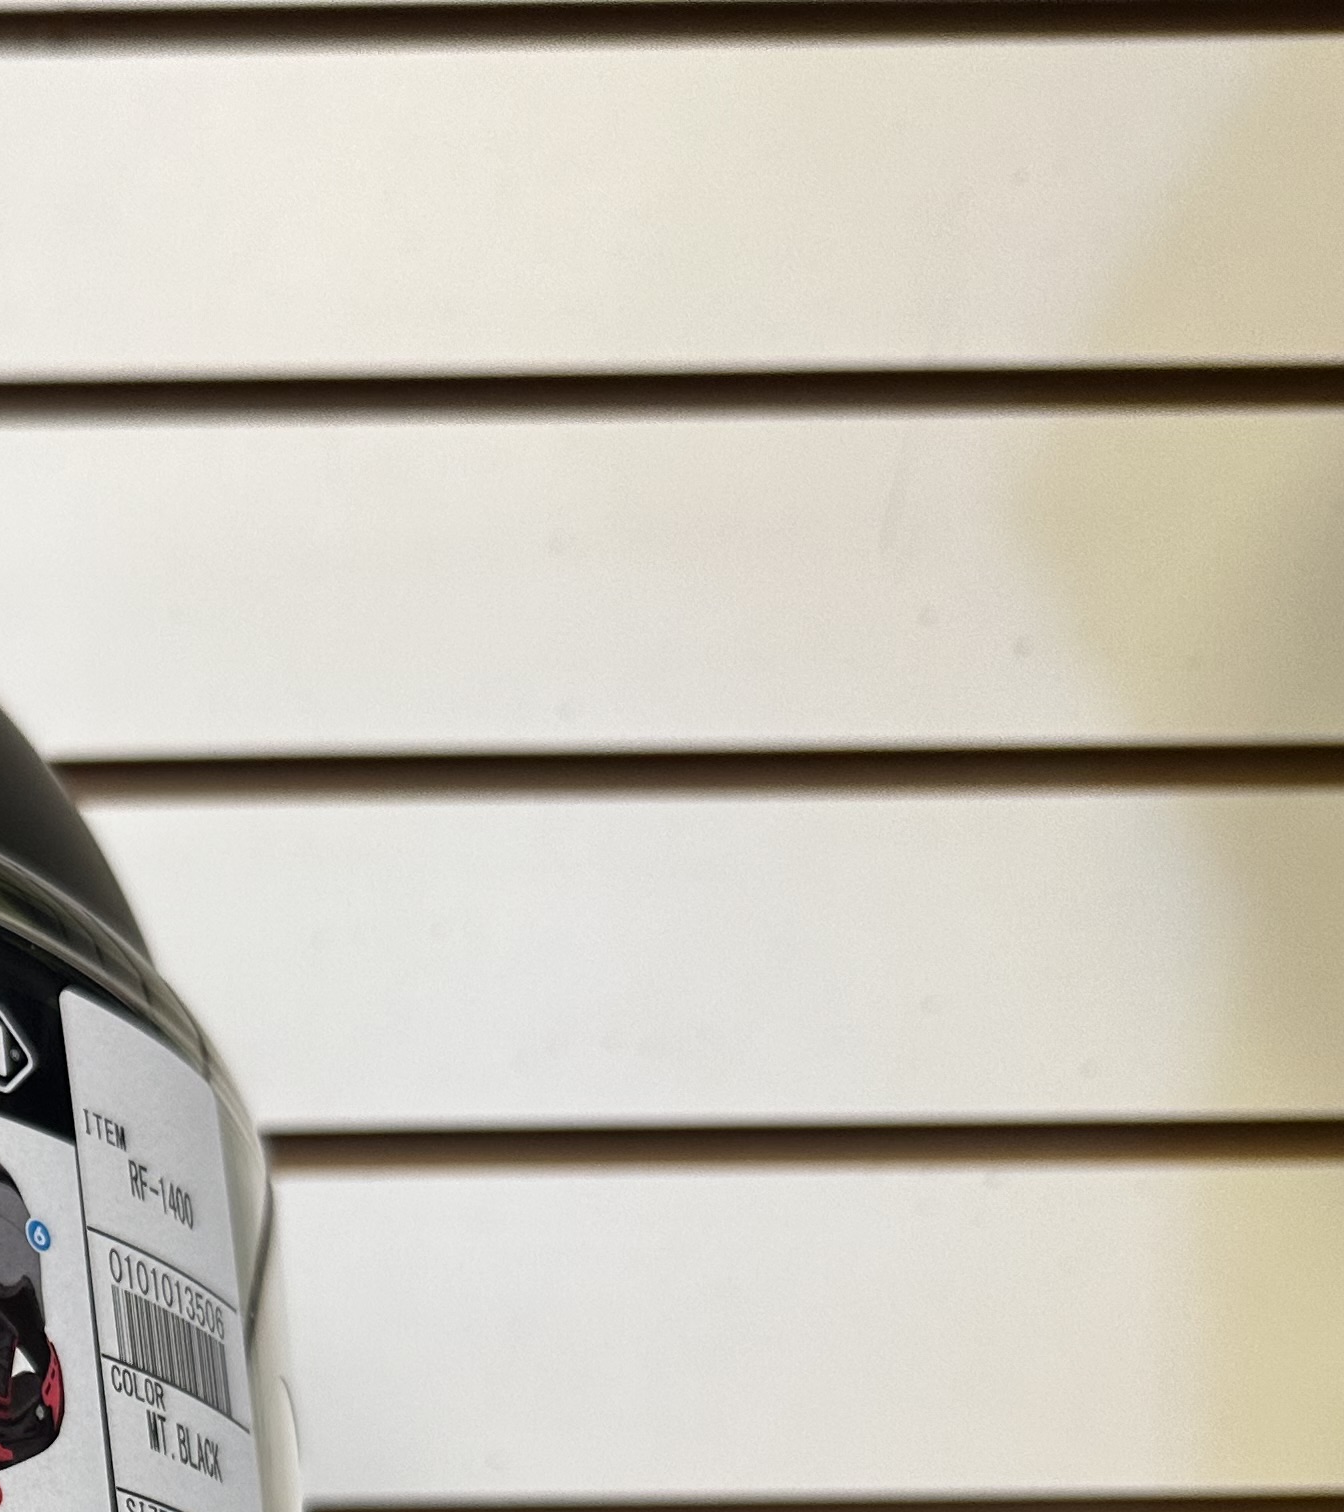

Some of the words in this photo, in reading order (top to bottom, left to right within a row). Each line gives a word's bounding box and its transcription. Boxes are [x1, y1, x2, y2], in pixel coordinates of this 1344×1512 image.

[83, 1109, 127, 1152] ITEM
[128, 1159, 194, 1231] RF-1400
[112, 1365, 165, 1412] COLOR
